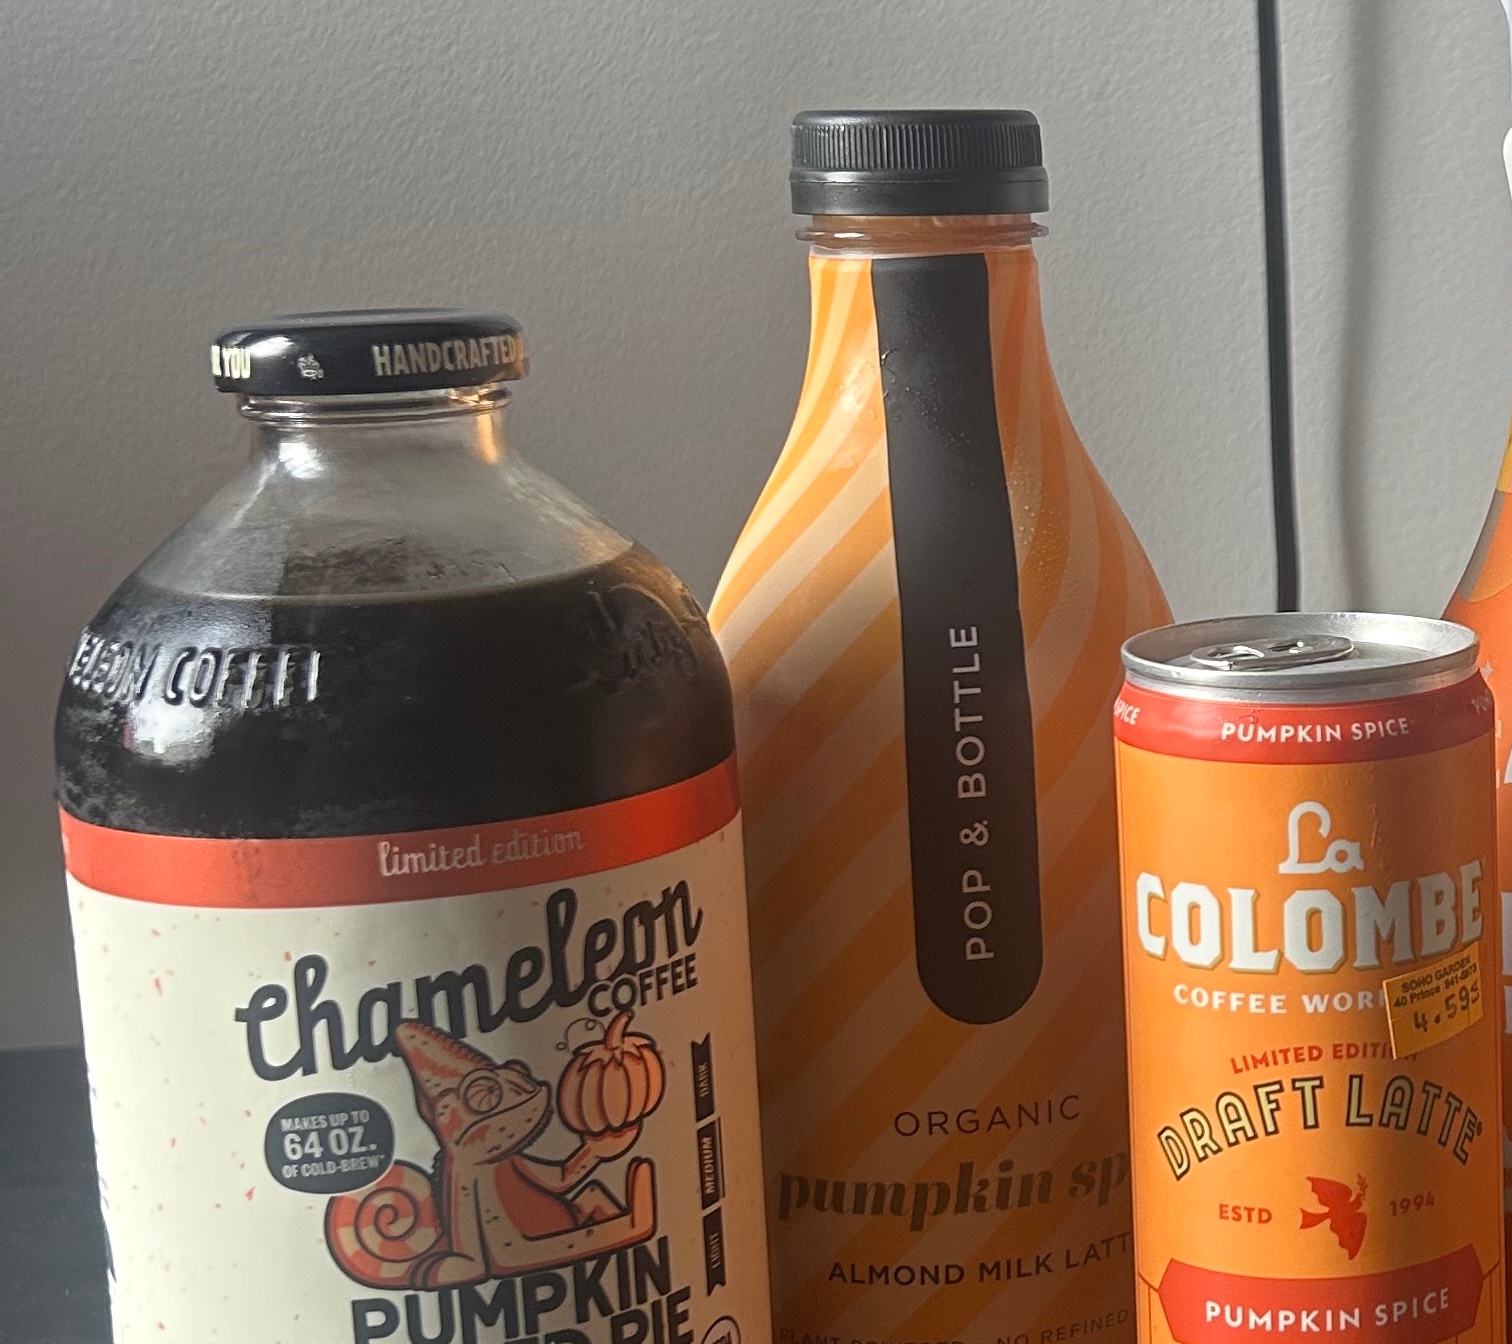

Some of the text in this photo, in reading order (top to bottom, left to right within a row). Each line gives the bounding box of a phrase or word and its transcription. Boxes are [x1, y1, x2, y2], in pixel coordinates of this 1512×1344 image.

[222, 345, 251, 379] YOU
[371, 334, 516, 377] HANDCRAFTED
[1220, 717, 1411, 743] PUMPKIN SPICE
[950, 624, 995, 962] POP & BOTTLE
[378, 828, 587, 877] limited edition
[1278, 801, 1364, 875] La
[1136, 859, 1485, 974] COLOMBE
[234, 879, 705, 1082] Chameleon
[589, 953, 699, 1018] COFFEE
[1173, 983, 1288, 1014] COFFEE
[1393, 995, 1408, 1008] 40
[1402, 973, 1434, 994] SOHO
[1230, 1044, 1324, 1075] LIMITED
[280, 1109, 371, 1131] MAKES UP TO
[893, 1094, 1081, 1137] ORGANIC
[1156, 1075, 1325, 1182] DRAFT
[282, 1126, 378, 1161] 64 OZ.
[281, 1162, 300, 1179] OF
[705, 1136, 716, 1196] MEDIUM
[777, 1158, 1055, 1233] pumpkin
[1218, 1191, 1436, 1225] ESTD 1994
[828, 1230, 1132, 1287] ALMOND MILK LATT
[1041, 1308, 1130, 1344] REFINED
[1205, 1286, 1450, 1333] PUMPKIN SPICE
